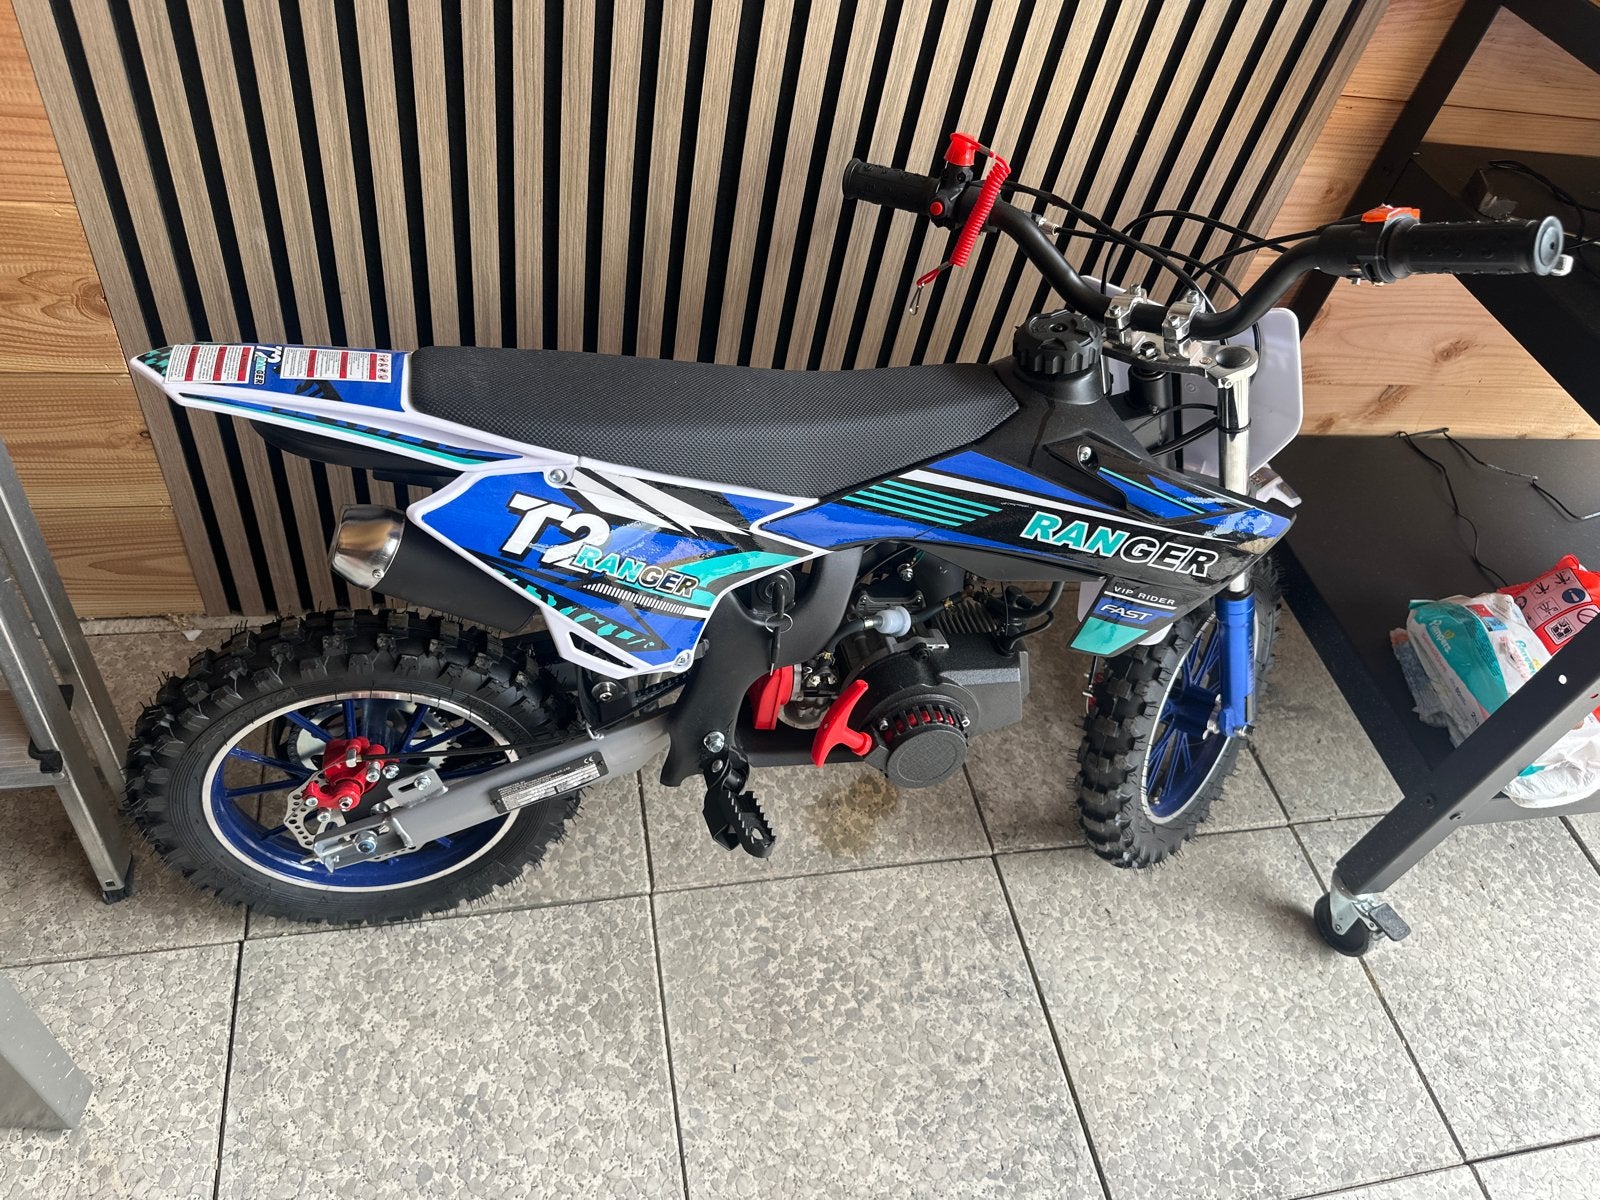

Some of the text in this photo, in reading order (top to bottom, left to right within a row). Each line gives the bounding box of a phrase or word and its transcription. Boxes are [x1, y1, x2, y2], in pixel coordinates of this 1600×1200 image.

[1020, 511, 1219, 577] RANGER
[573, 545, 700, 598] RANGER
[1101, 605, 1152, 620] FAST
[1114, 585, 1175, 606] VIP RIDER
[1429, 619, 1451, 653] Pampers
